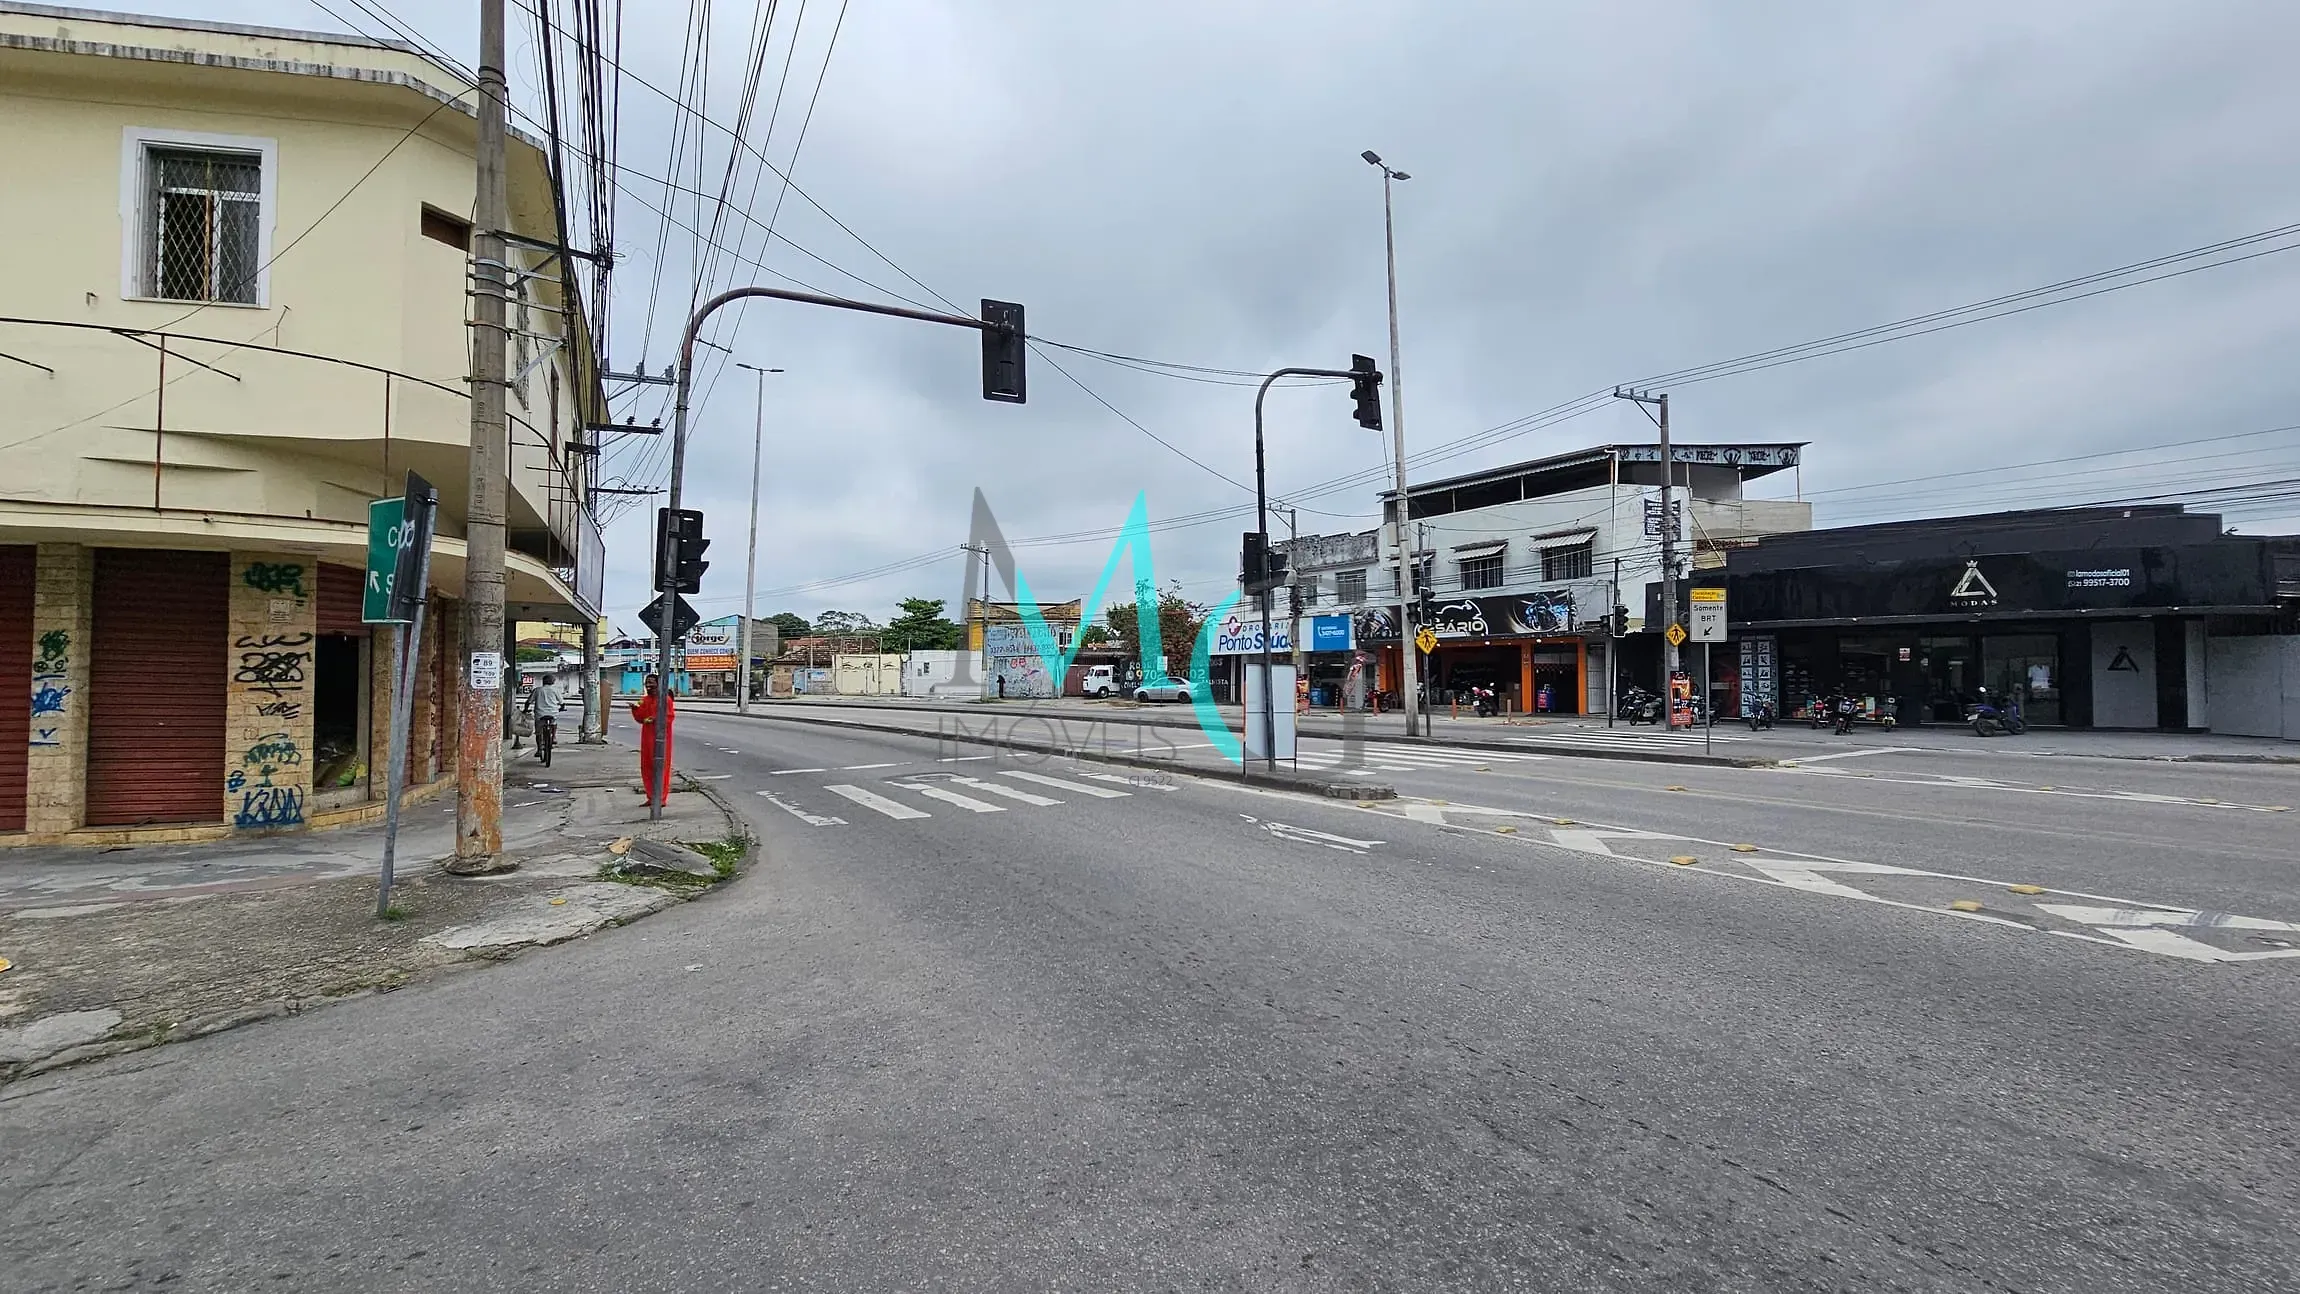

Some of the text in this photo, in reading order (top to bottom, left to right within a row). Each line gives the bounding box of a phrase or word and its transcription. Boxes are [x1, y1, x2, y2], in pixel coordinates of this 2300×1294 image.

[2082, 578, 2130, 587] 99517-3700
[1701, 614, 1717, 622] BRT
[1218, 634, 1253, 651] Ponto
